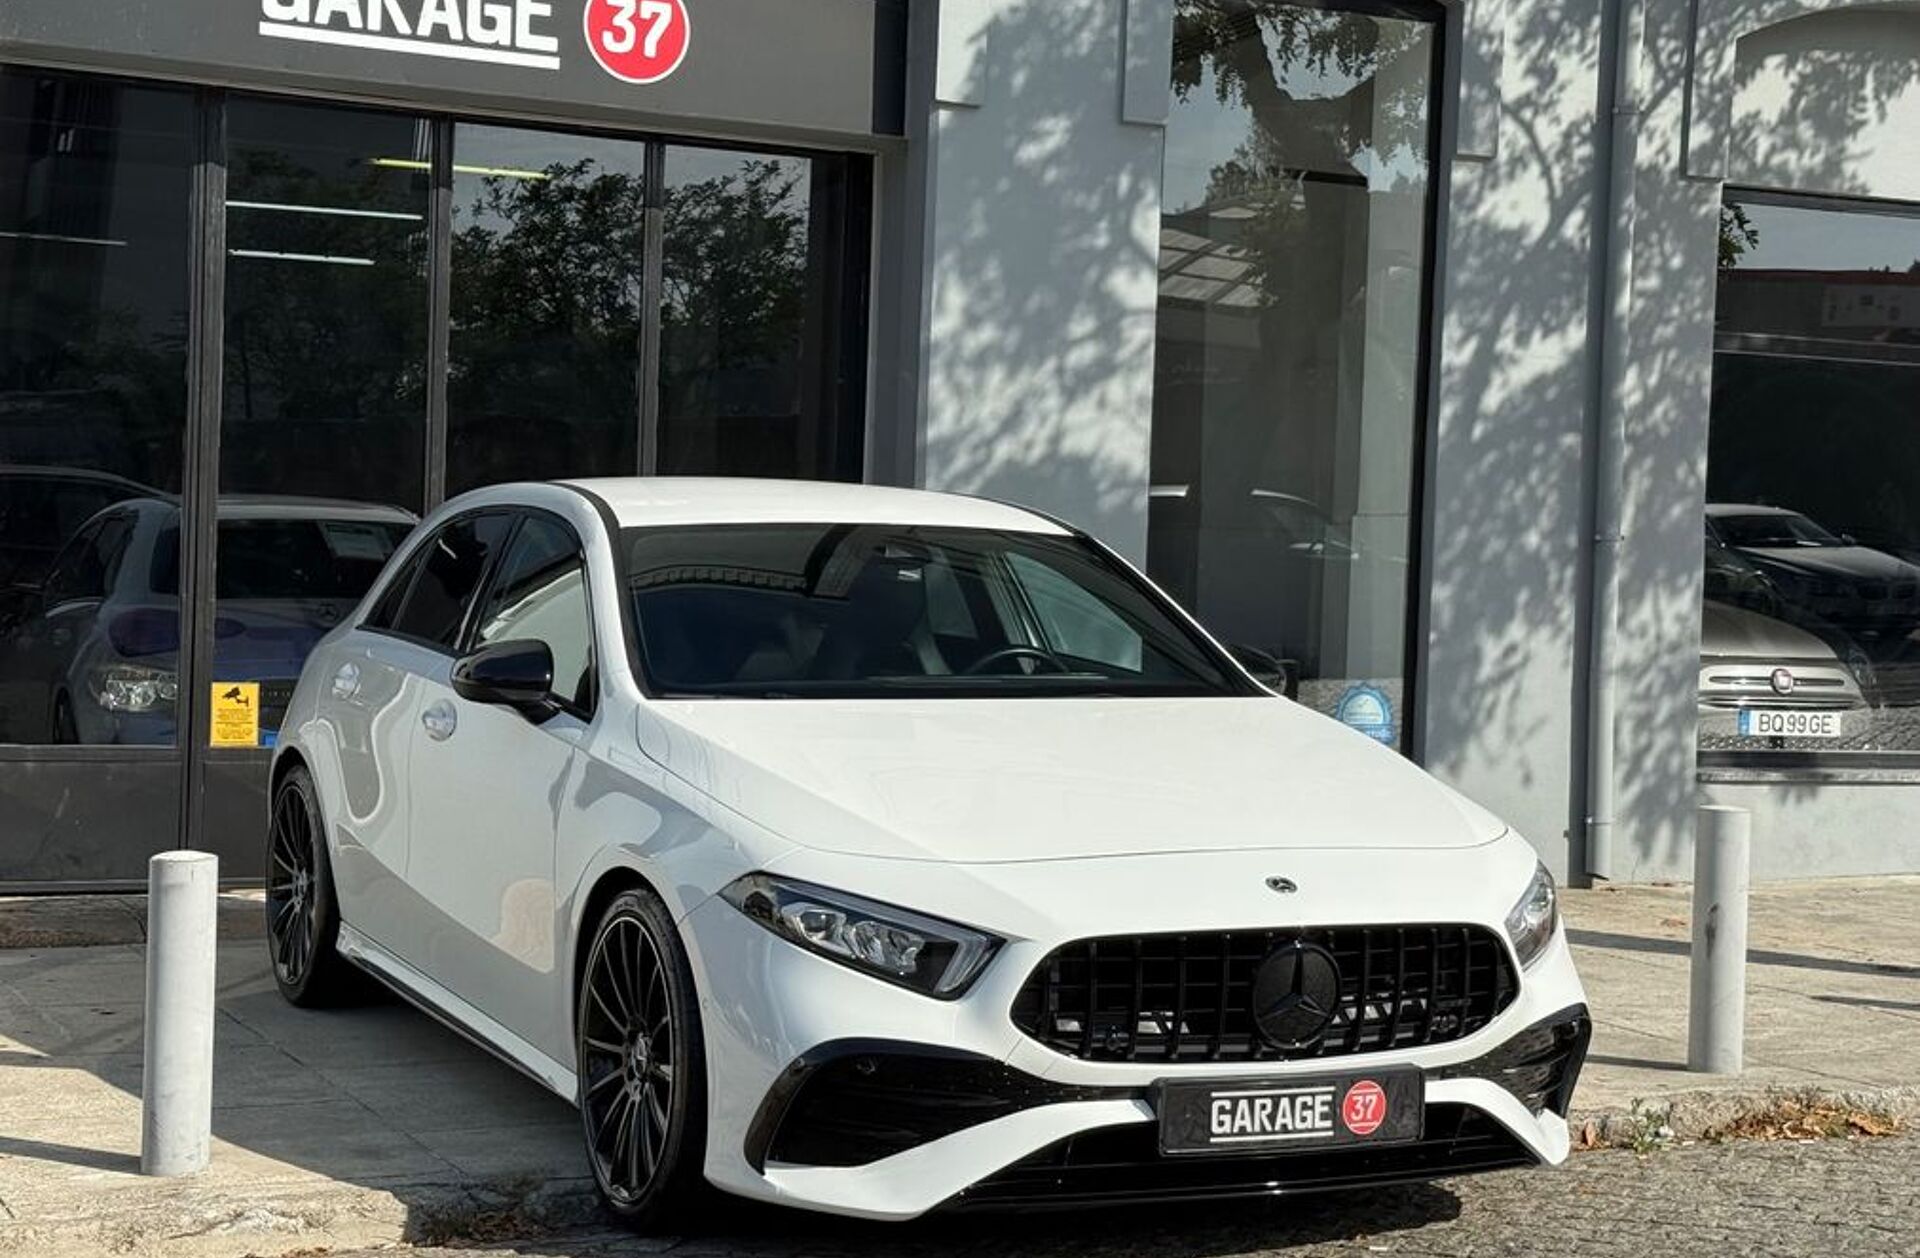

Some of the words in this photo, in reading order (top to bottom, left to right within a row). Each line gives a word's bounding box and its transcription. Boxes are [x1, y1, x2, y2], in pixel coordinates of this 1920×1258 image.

[602, 0, 672, 58] 37
[1211, 1094, 1333, 1134] GARAGE
[1350, 1095, 1378, 1121] 37
